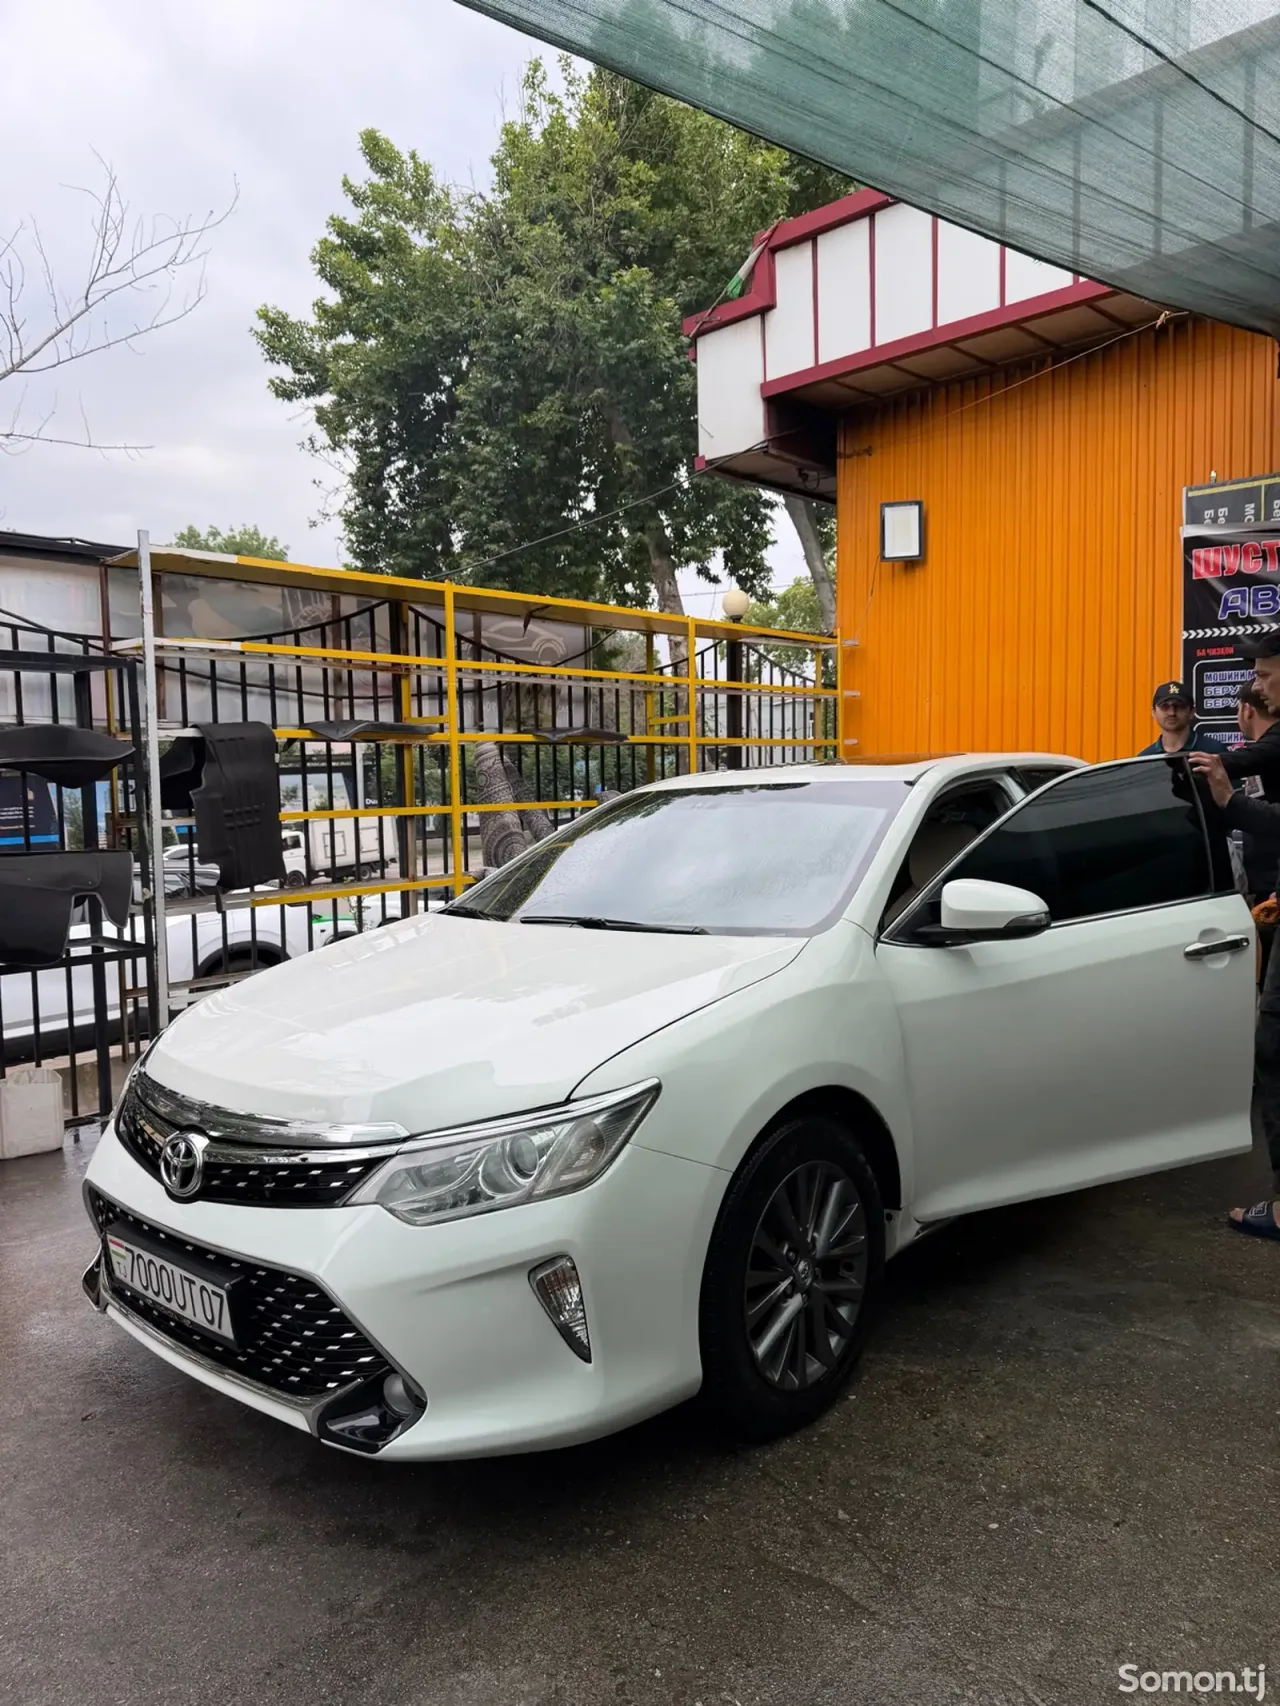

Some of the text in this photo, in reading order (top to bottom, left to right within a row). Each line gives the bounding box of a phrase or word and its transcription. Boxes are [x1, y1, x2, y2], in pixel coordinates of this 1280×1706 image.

[1192, 540, 1280, 580] ШУСТ
[1218, 584, 1280, 620] АВ
[1204, 670, 1247, 684] МОШИНИ
[1204, 685, 1243, 697] БЕРУ
